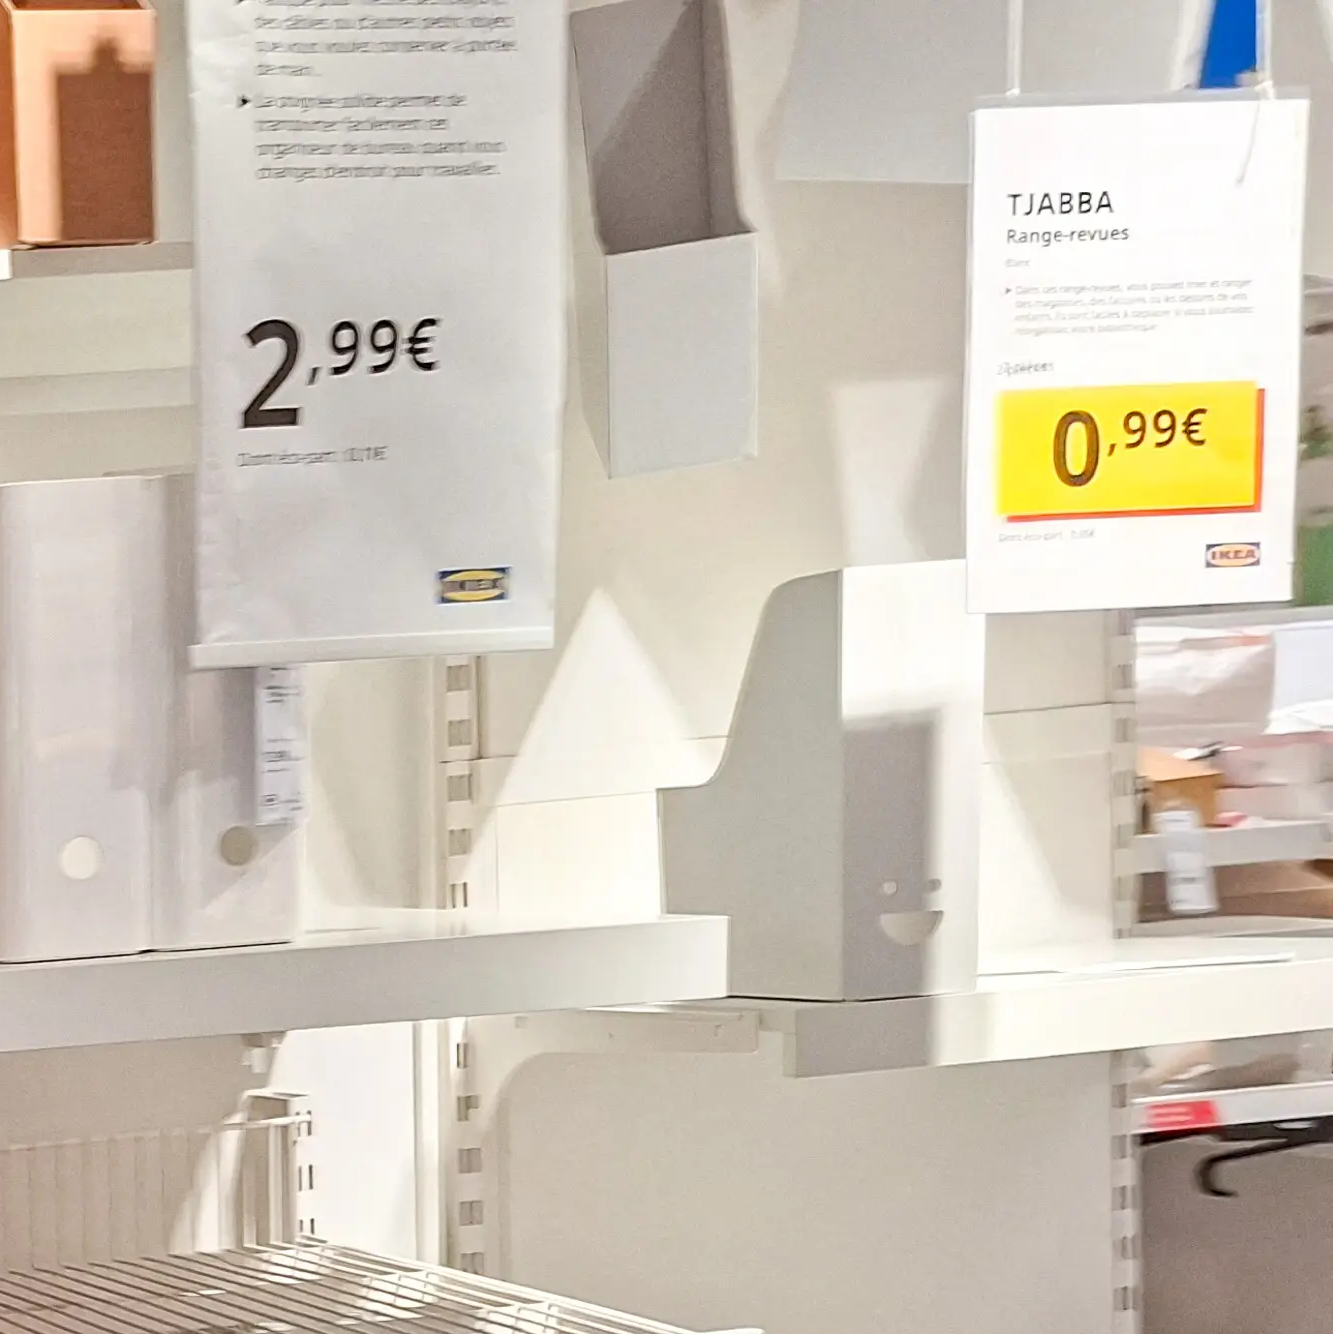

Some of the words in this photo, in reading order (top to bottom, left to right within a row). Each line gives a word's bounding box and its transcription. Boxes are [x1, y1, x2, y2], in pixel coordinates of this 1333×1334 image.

[1007, 190, 1114, 217] TJABBA
[1006, 226, 1130, 246] Range-revues
[242, 319, 440, 428] 2,99€
[1052, 407, 1208, 487] 0,99€
[1209, 547, 1258, 563] IKEA
